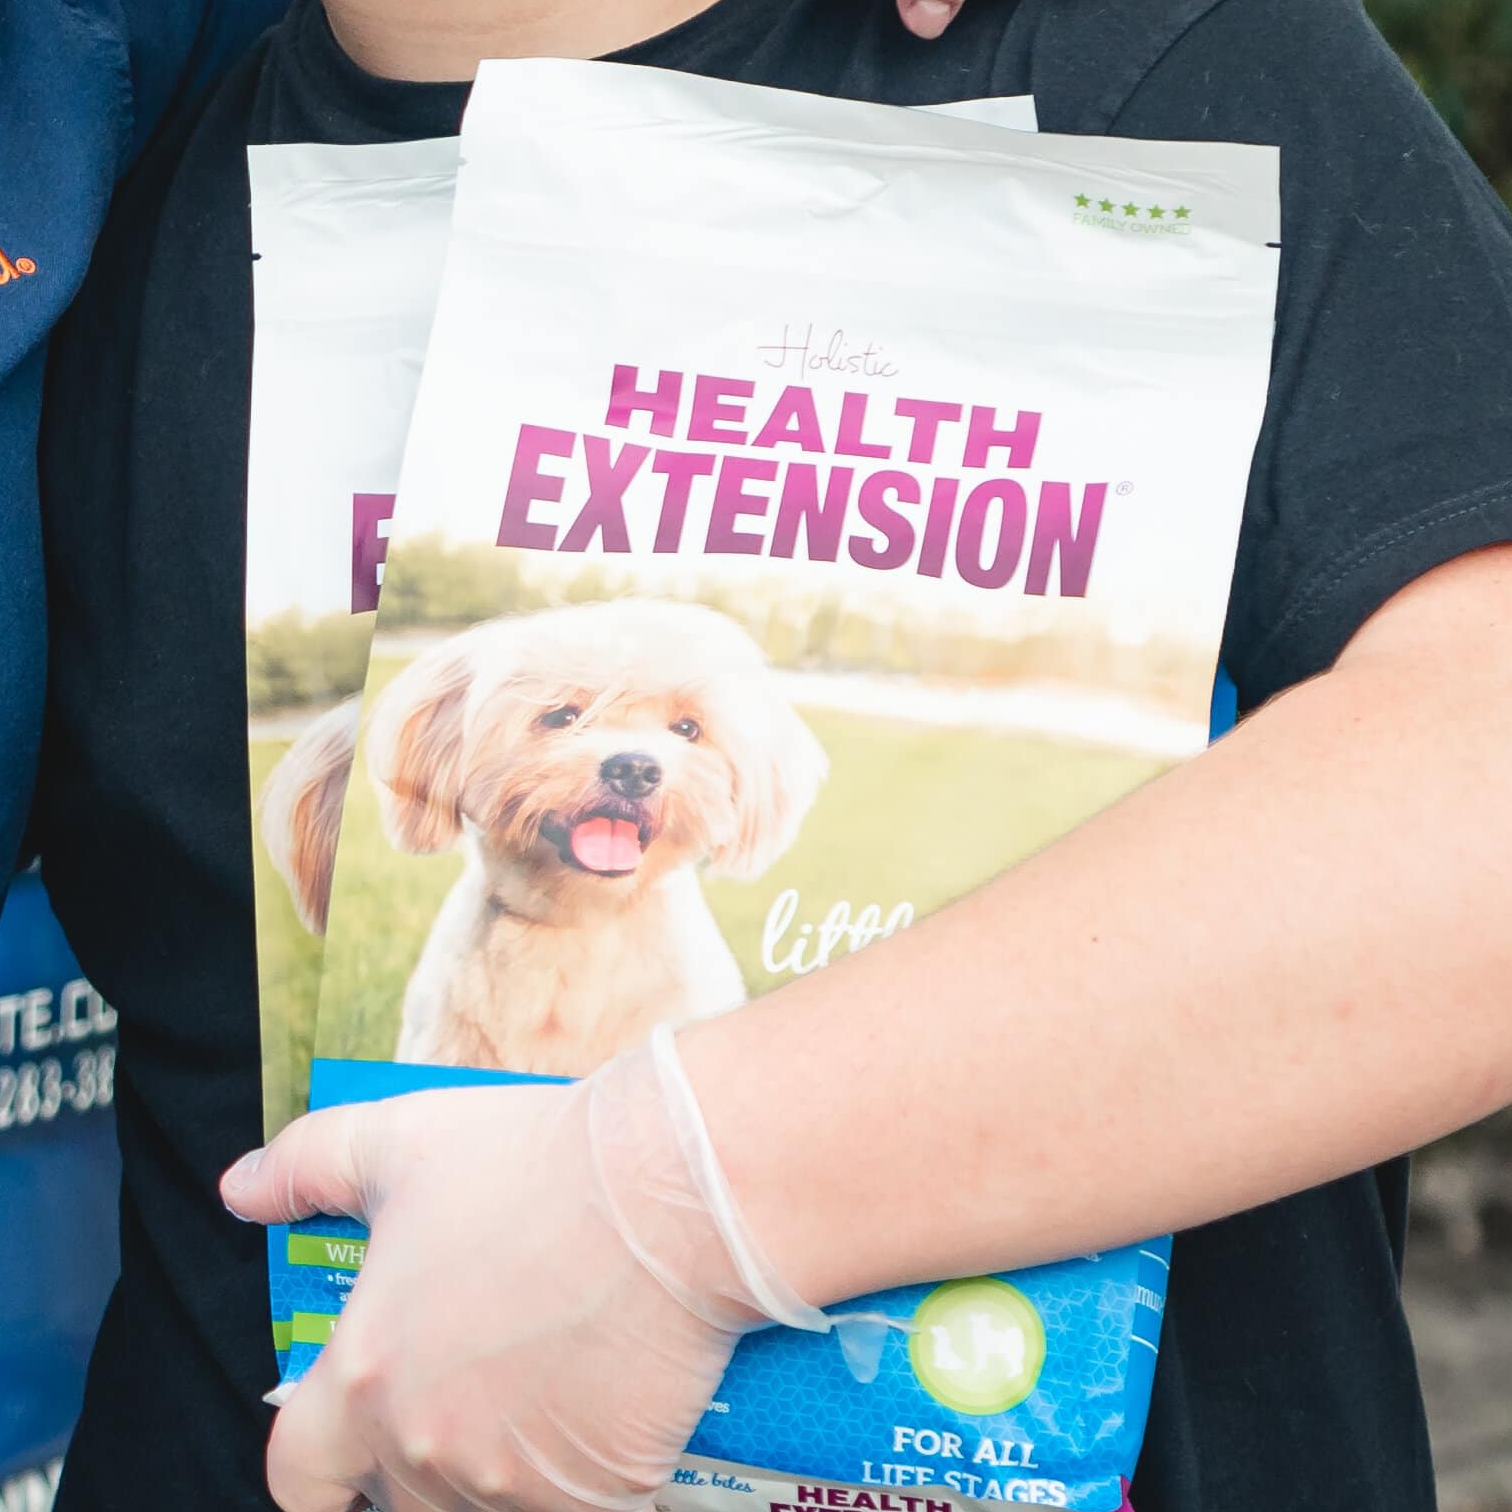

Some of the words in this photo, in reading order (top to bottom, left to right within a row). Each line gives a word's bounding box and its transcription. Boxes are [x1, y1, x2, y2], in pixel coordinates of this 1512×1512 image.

[757, 322, 902, 381] Holistic
[603, 362, 1043, 470] HEALTH
[494, 422, 1110, 599] EXTENSION
[892, 1425, 966, 1459] FOR
[972, 1437, 1040, 1469] ALL
[712, 1472, 757, 1493] bites
[862, 1460, 934, 1488] LIFE
[943, 1469, 1069, 1507] STAGES
